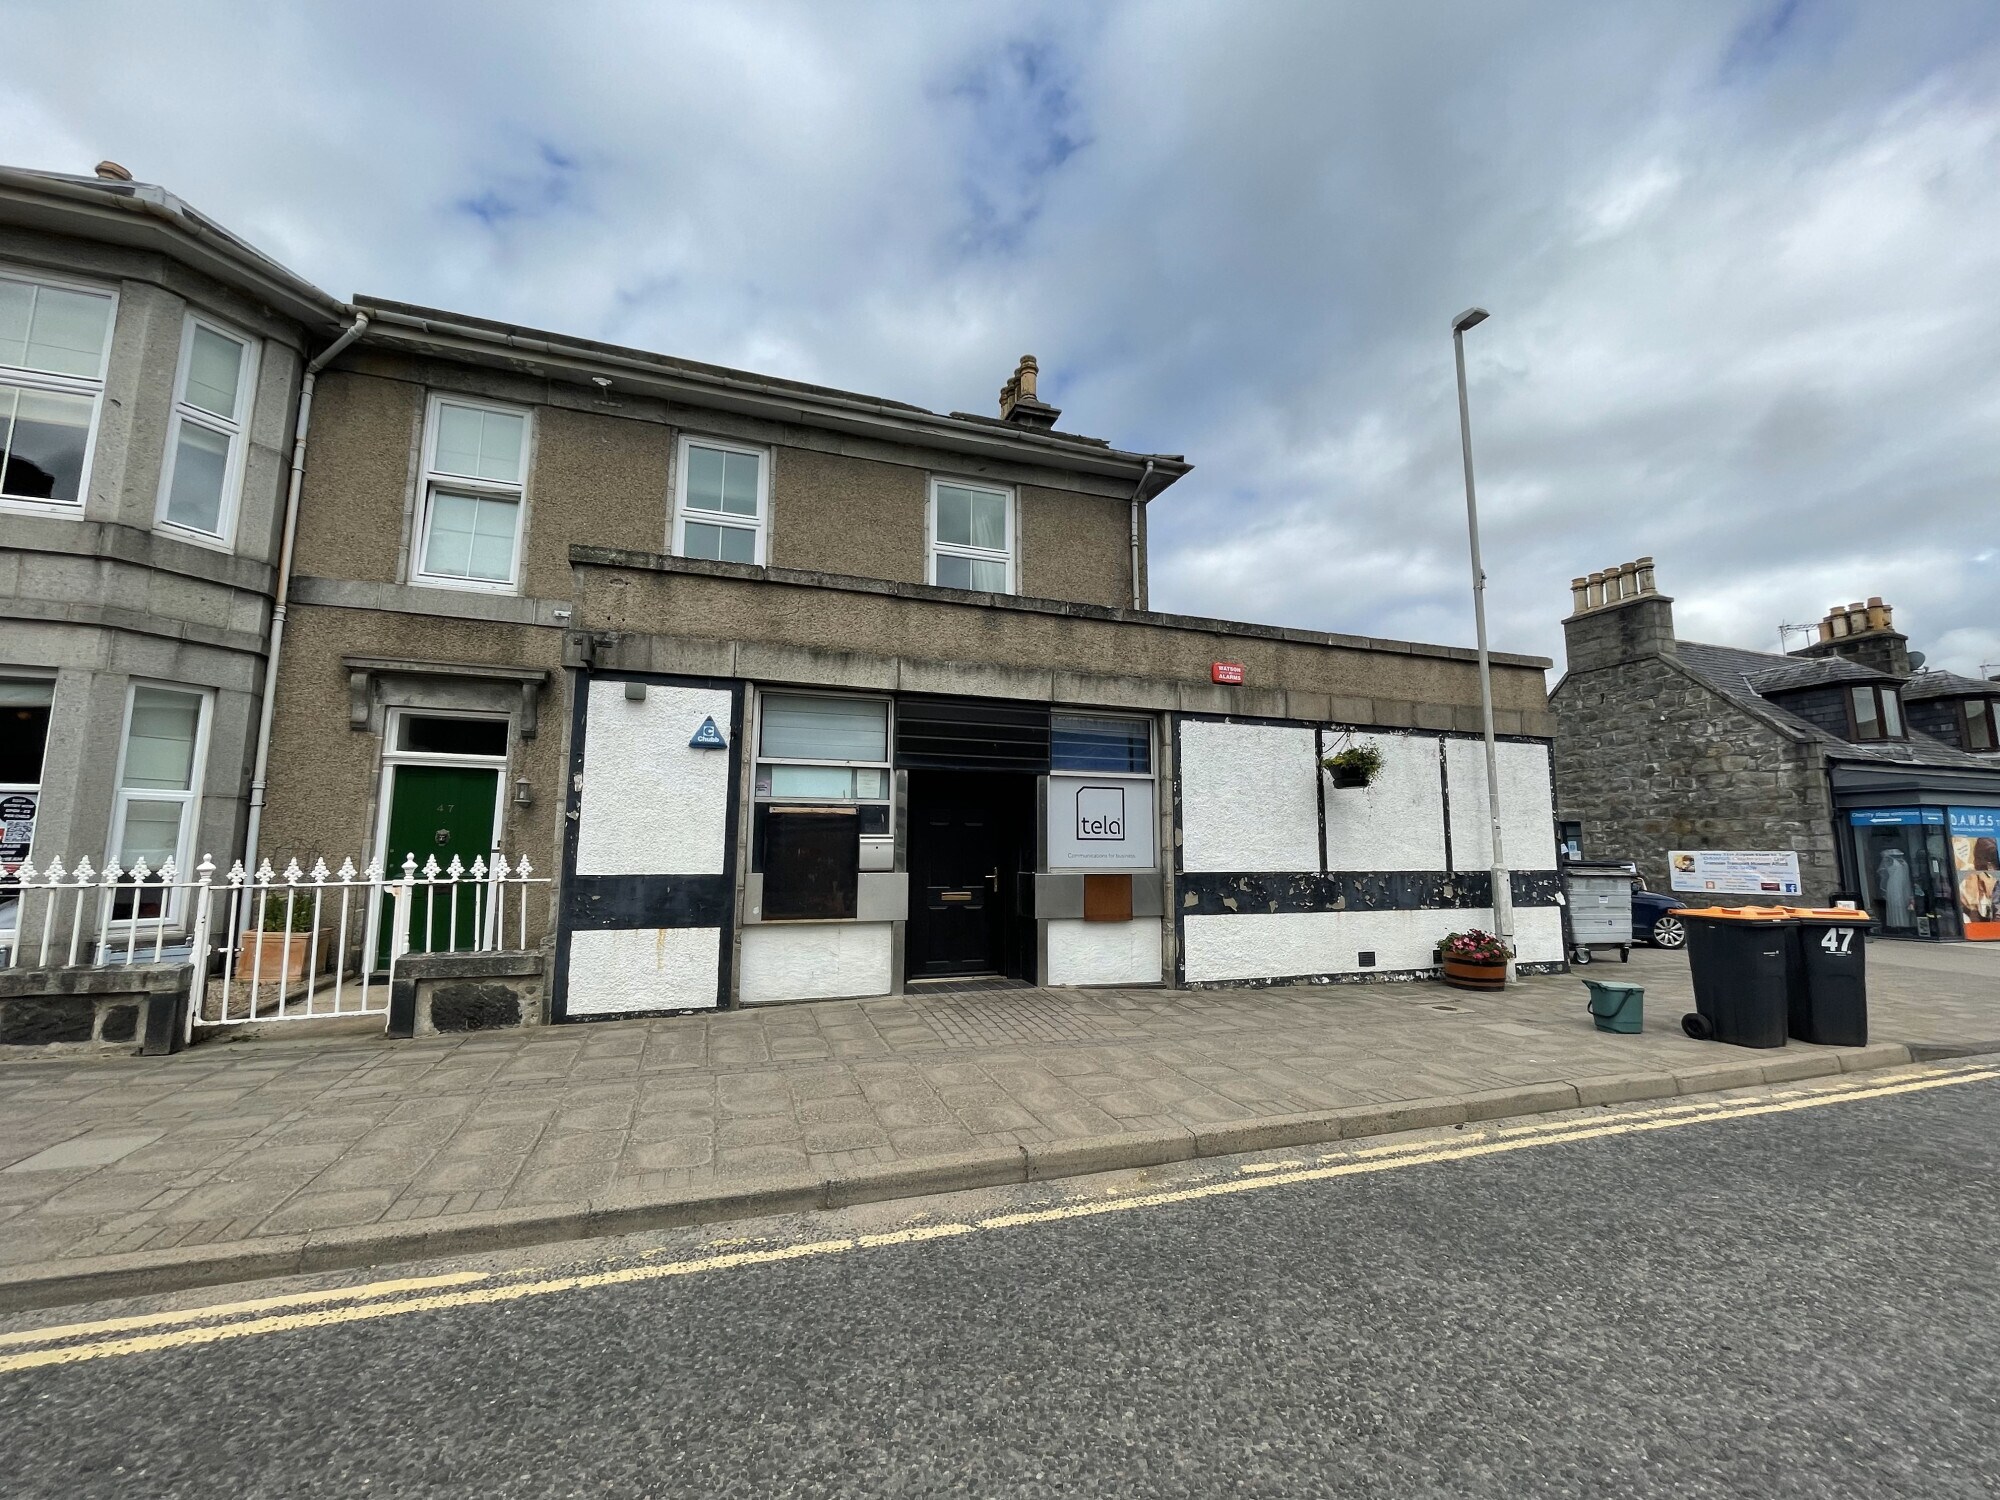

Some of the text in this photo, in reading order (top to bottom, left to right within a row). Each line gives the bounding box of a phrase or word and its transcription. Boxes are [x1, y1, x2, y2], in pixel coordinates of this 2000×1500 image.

[437, 804, 455, 812] 47
[1081, 815, 1120, 834] tela
[1821, 927, 1855, 952] 47
